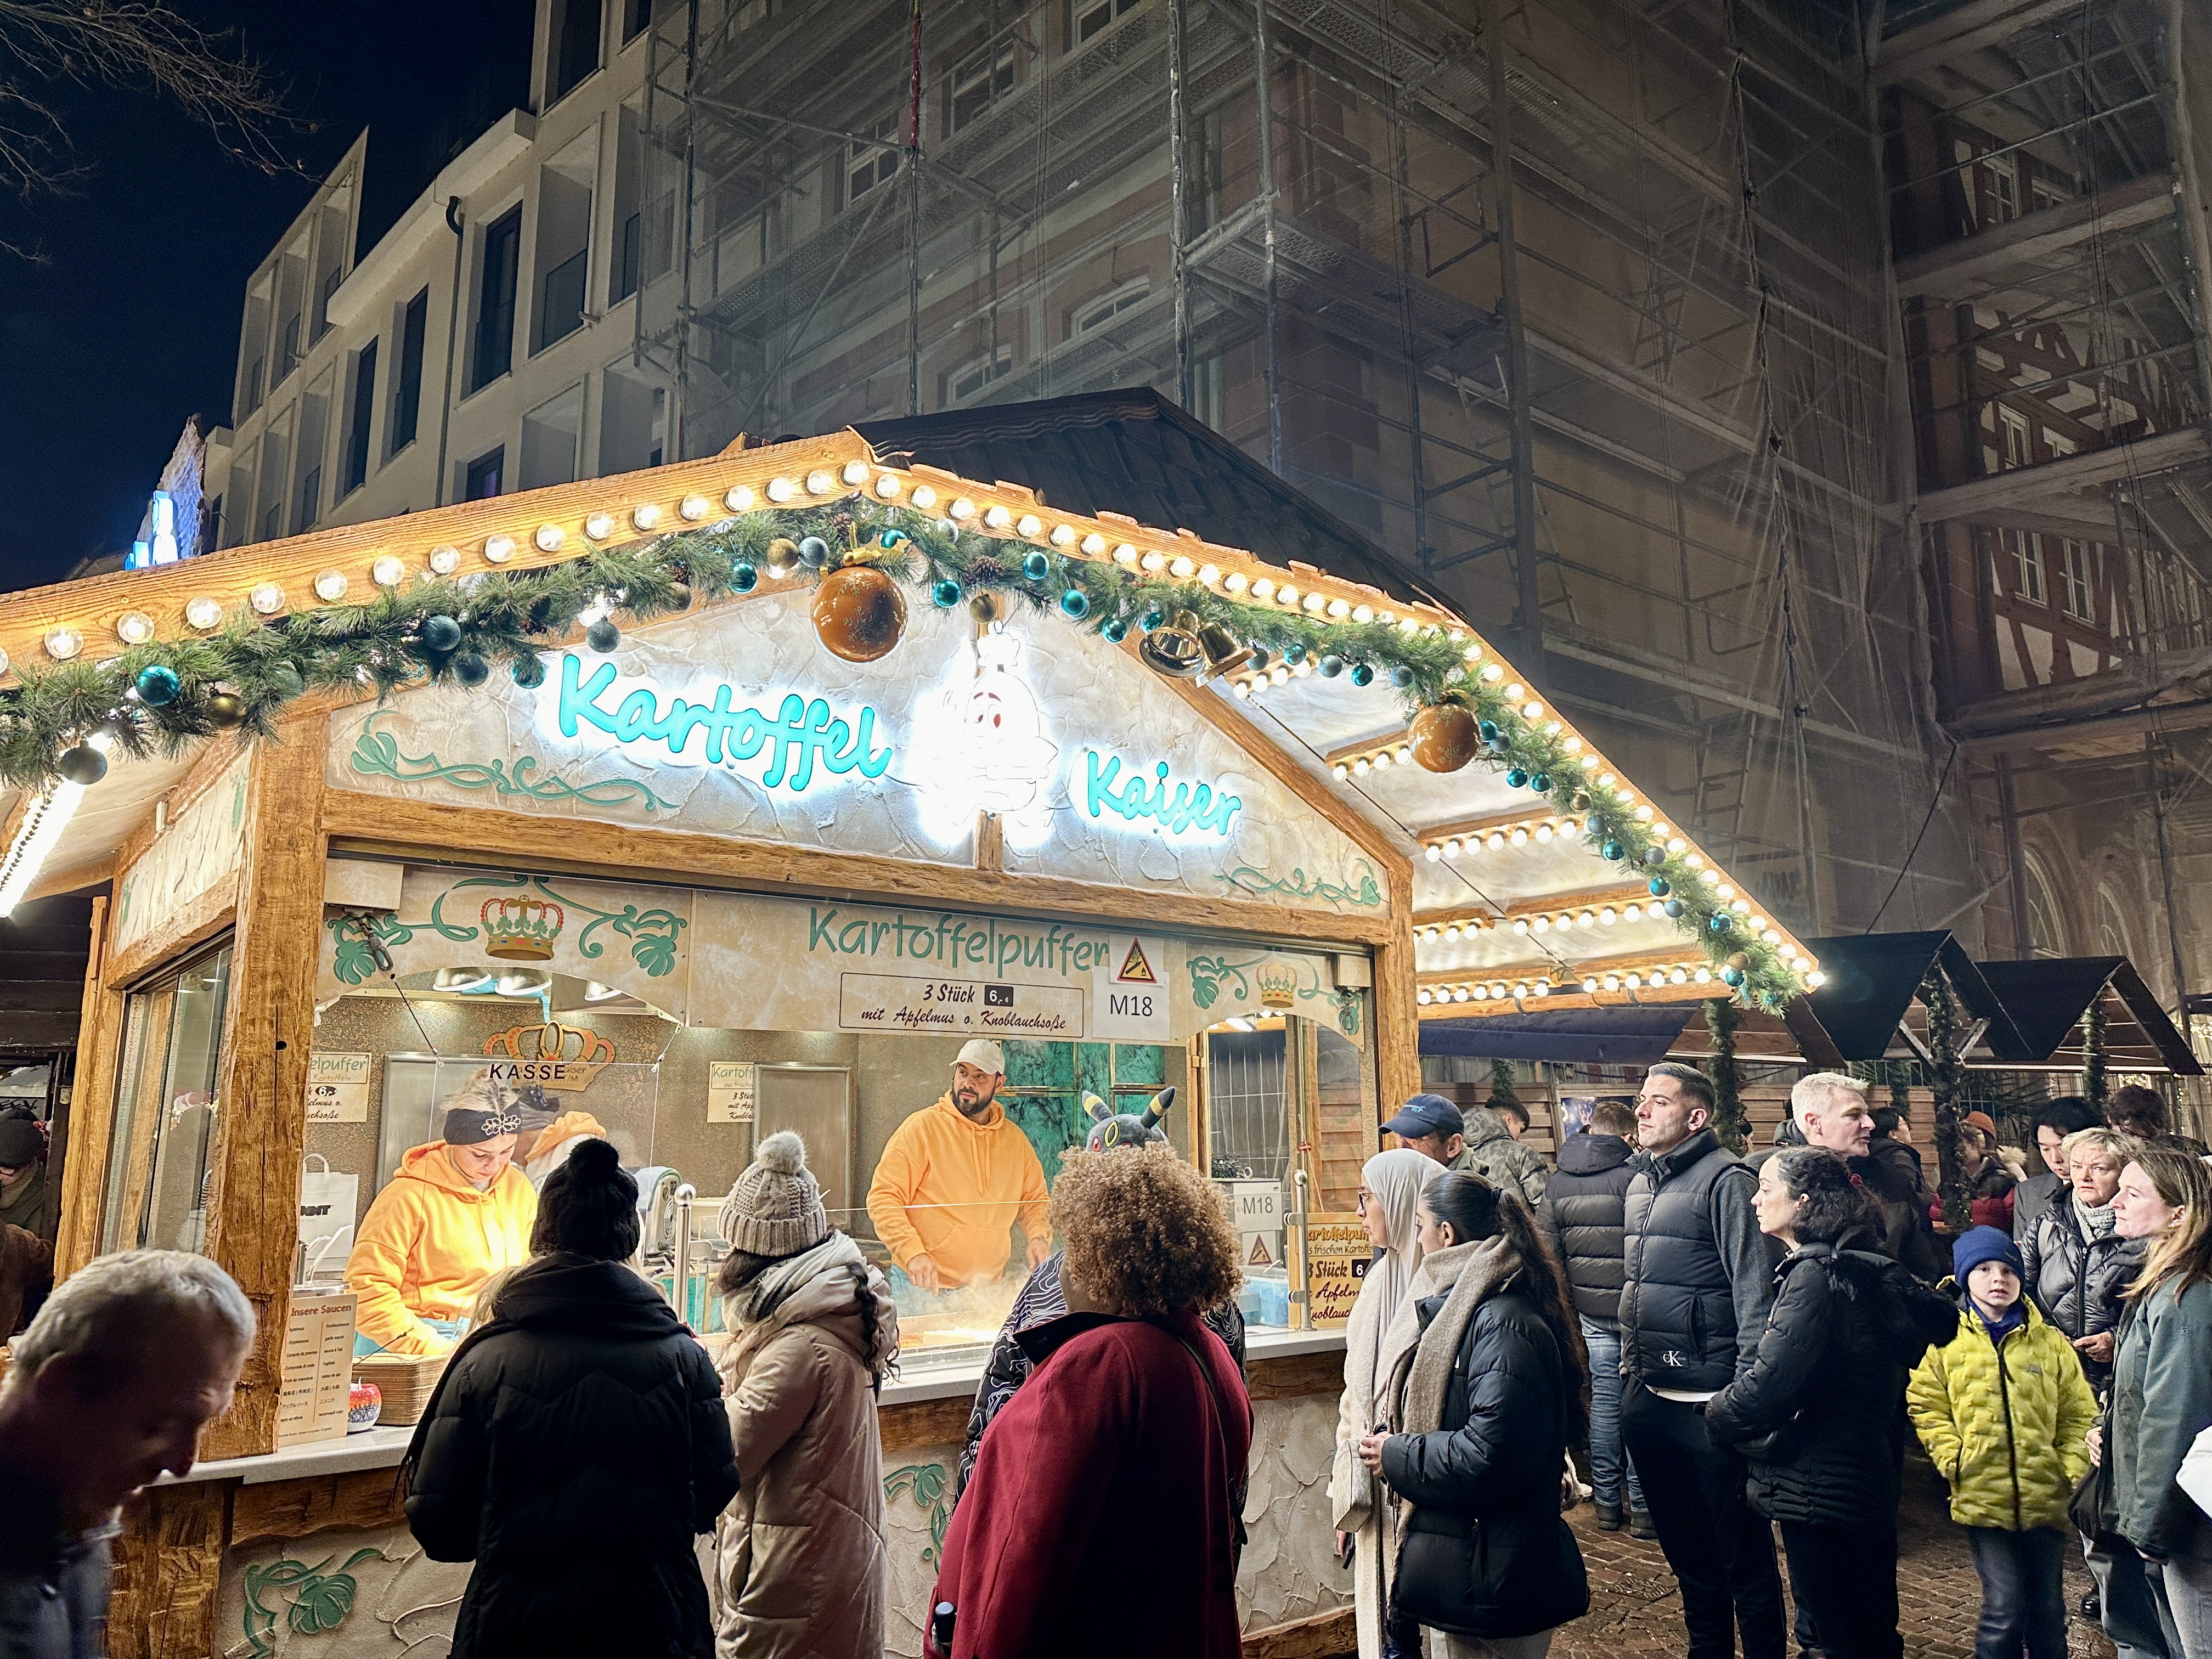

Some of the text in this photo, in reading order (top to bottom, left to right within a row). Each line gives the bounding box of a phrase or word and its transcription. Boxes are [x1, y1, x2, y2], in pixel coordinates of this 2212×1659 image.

[559, 654, 1242, 835] Kartoffel Kaiser
[809, 907, 1109, 978] Kartoffelpuffer
[923, 984, 933, 1001] 3
[937, 984, 975, 1003] Stück
[1110, 994, 1153, 1017] M18
[861, 1006, 1066, 1031] mit Apfelmus o. Knoblauchsoße
[311, 1056, 366, 1074] elpuffer
[489, 1064, 566, 1080] KASSE
[729, 1111, 754, 1120] Knobla
[1243, 1197, 1273, 1214] M18
[1308, 1226, 1369, 1244] artoffelpu
[1314, 1245, 1343, 1254] frischen
[1316, 1260, 1348, 1278] Stück
[321, 1305, 352, 1314] Saucen
